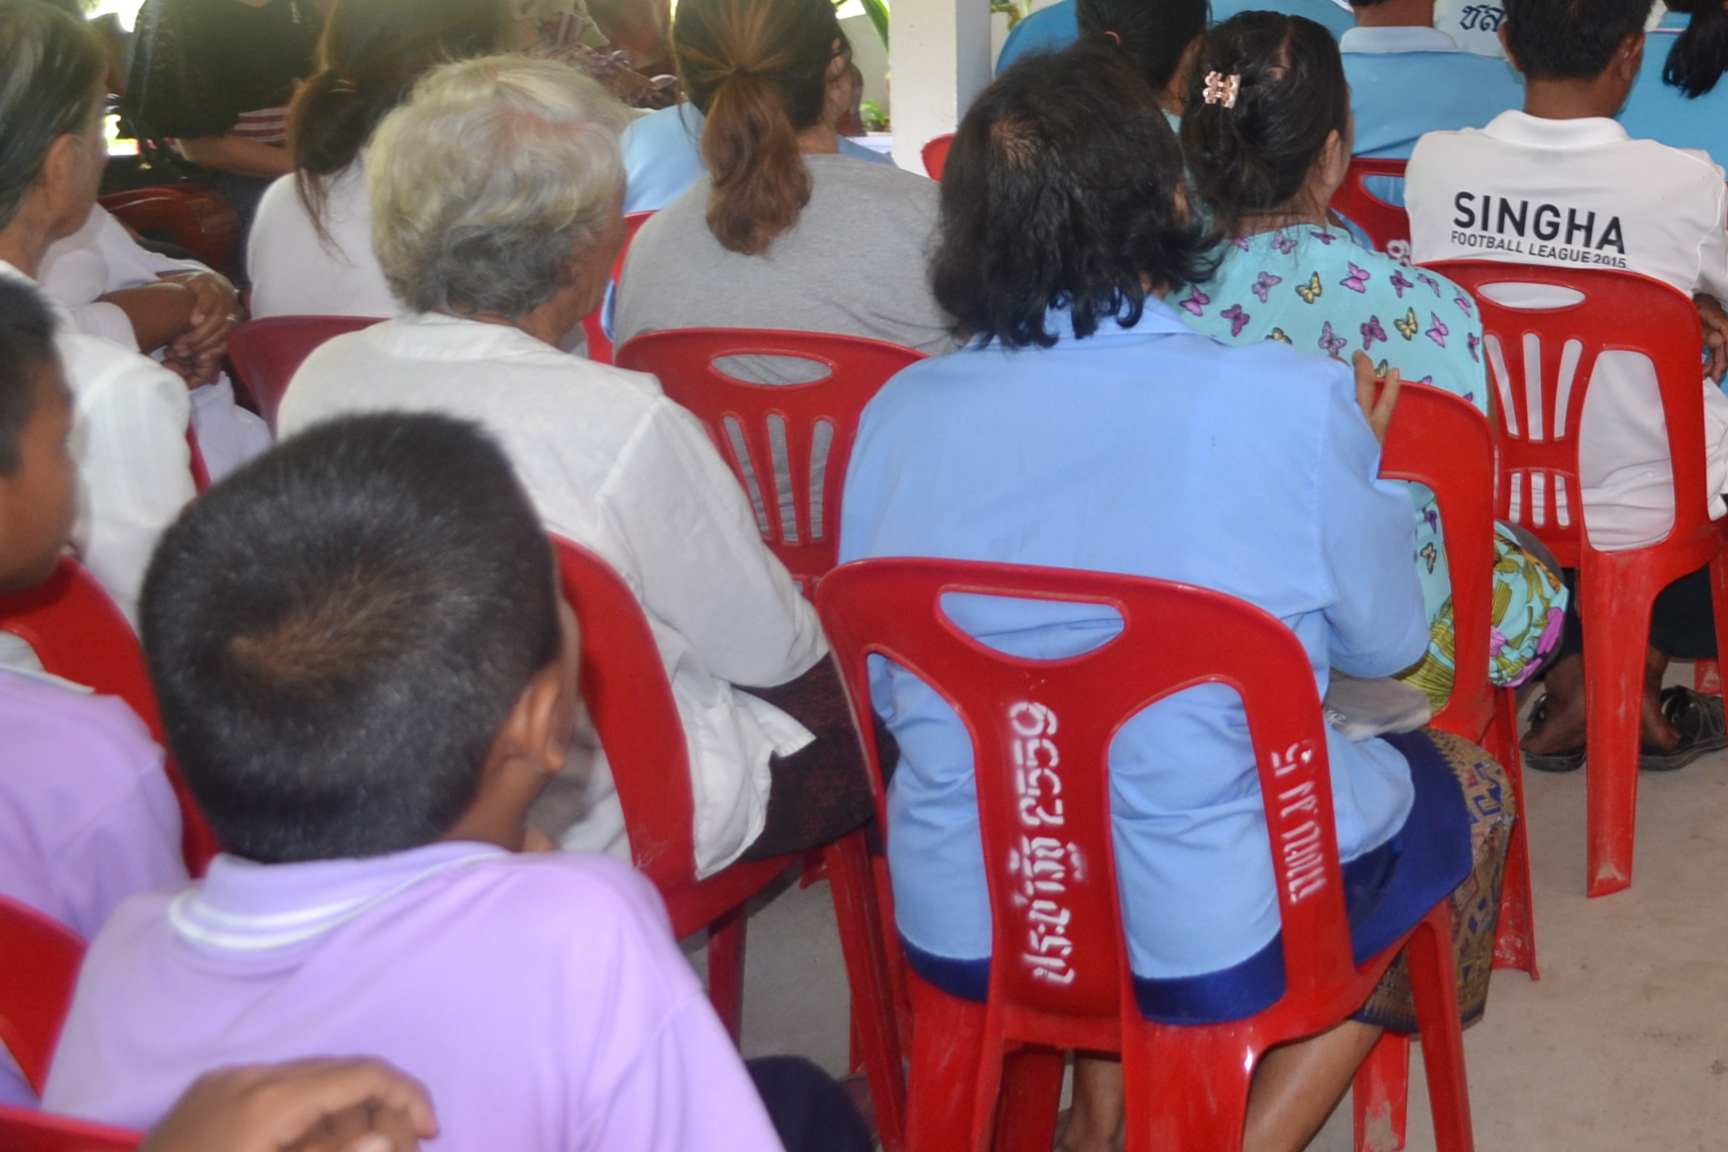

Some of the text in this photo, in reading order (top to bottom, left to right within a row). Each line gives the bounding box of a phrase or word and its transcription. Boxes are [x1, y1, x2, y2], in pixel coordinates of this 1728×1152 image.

[1451, 231, 1627, 269] FOOTBALL LEAGUE 2015
[1453, 191, 1626, 254] SINGHA
[1009, 701, 1065, 827] 2559
